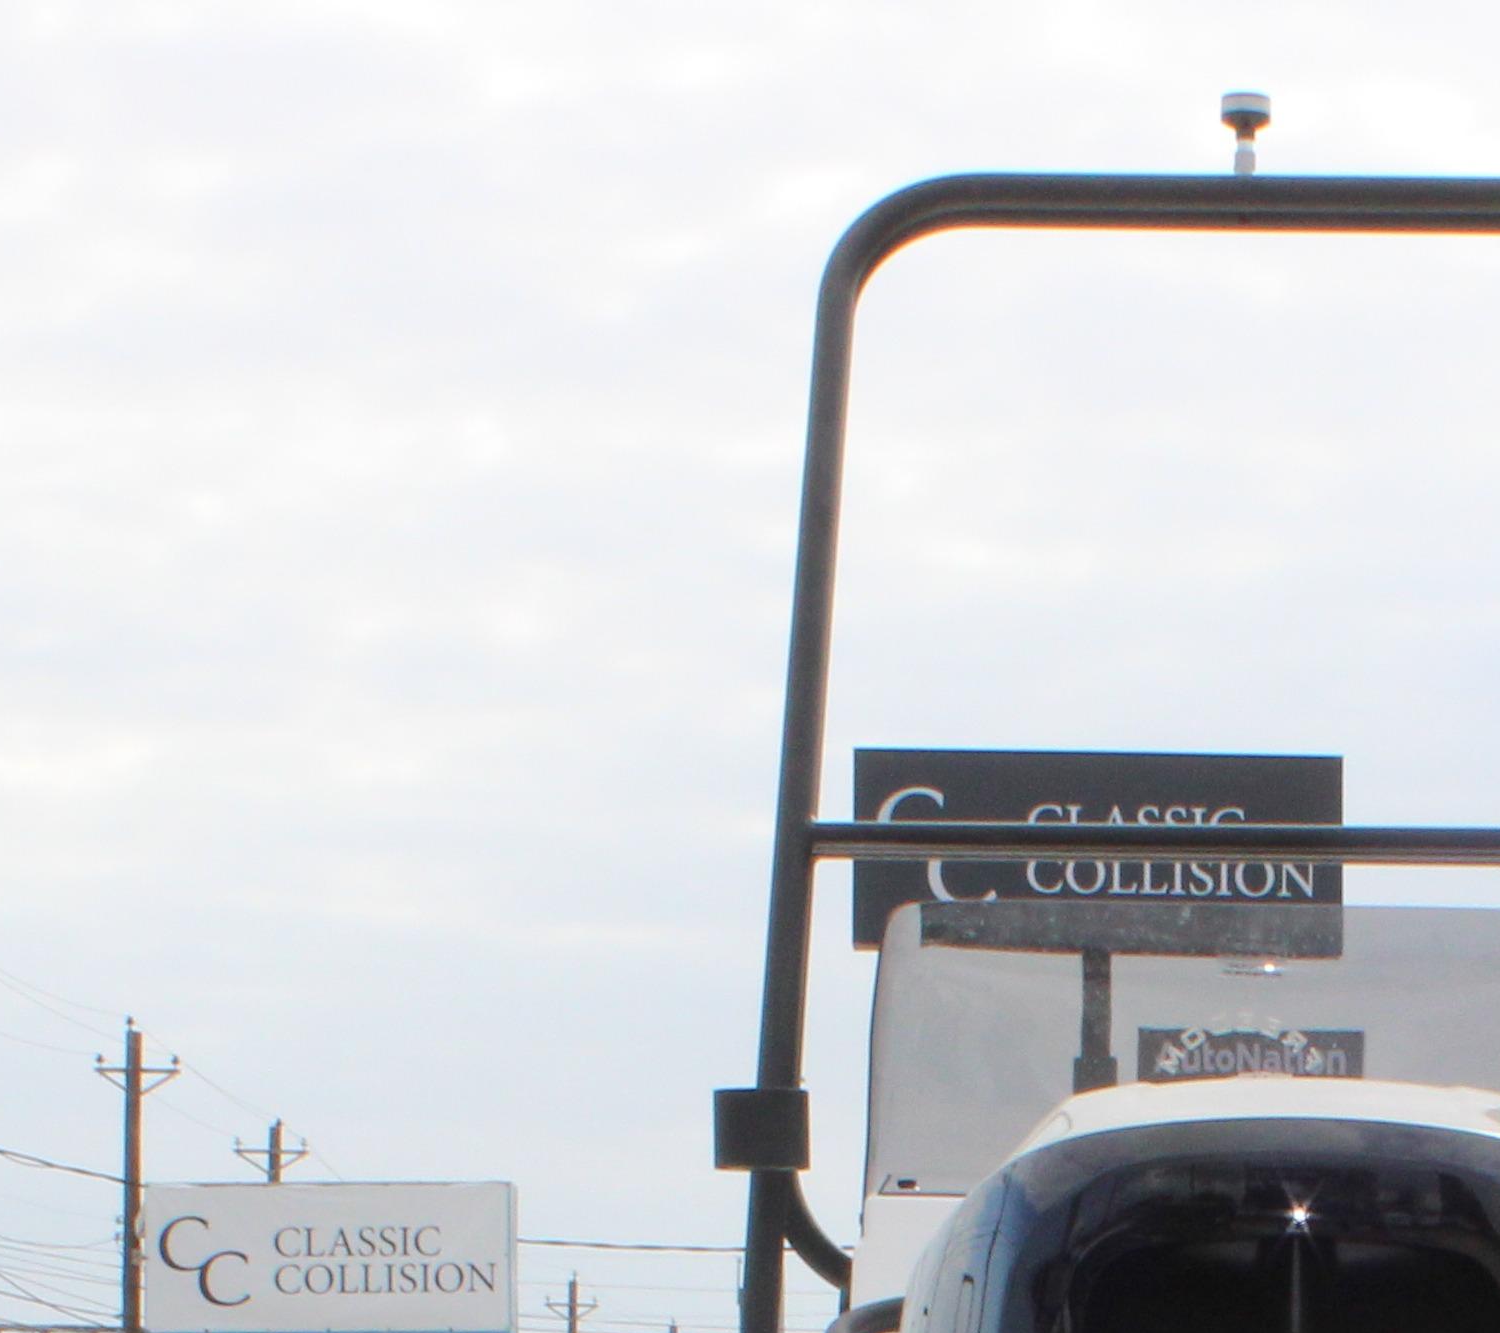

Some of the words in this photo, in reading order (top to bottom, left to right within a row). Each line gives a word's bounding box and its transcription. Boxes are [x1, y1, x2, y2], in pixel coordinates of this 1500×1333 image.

[1027, 860, 1315, 898] COLLISION
[274, 1226, 442, 1258] CLASSIC
[274, 1263, 497, 1295] COLLISION
